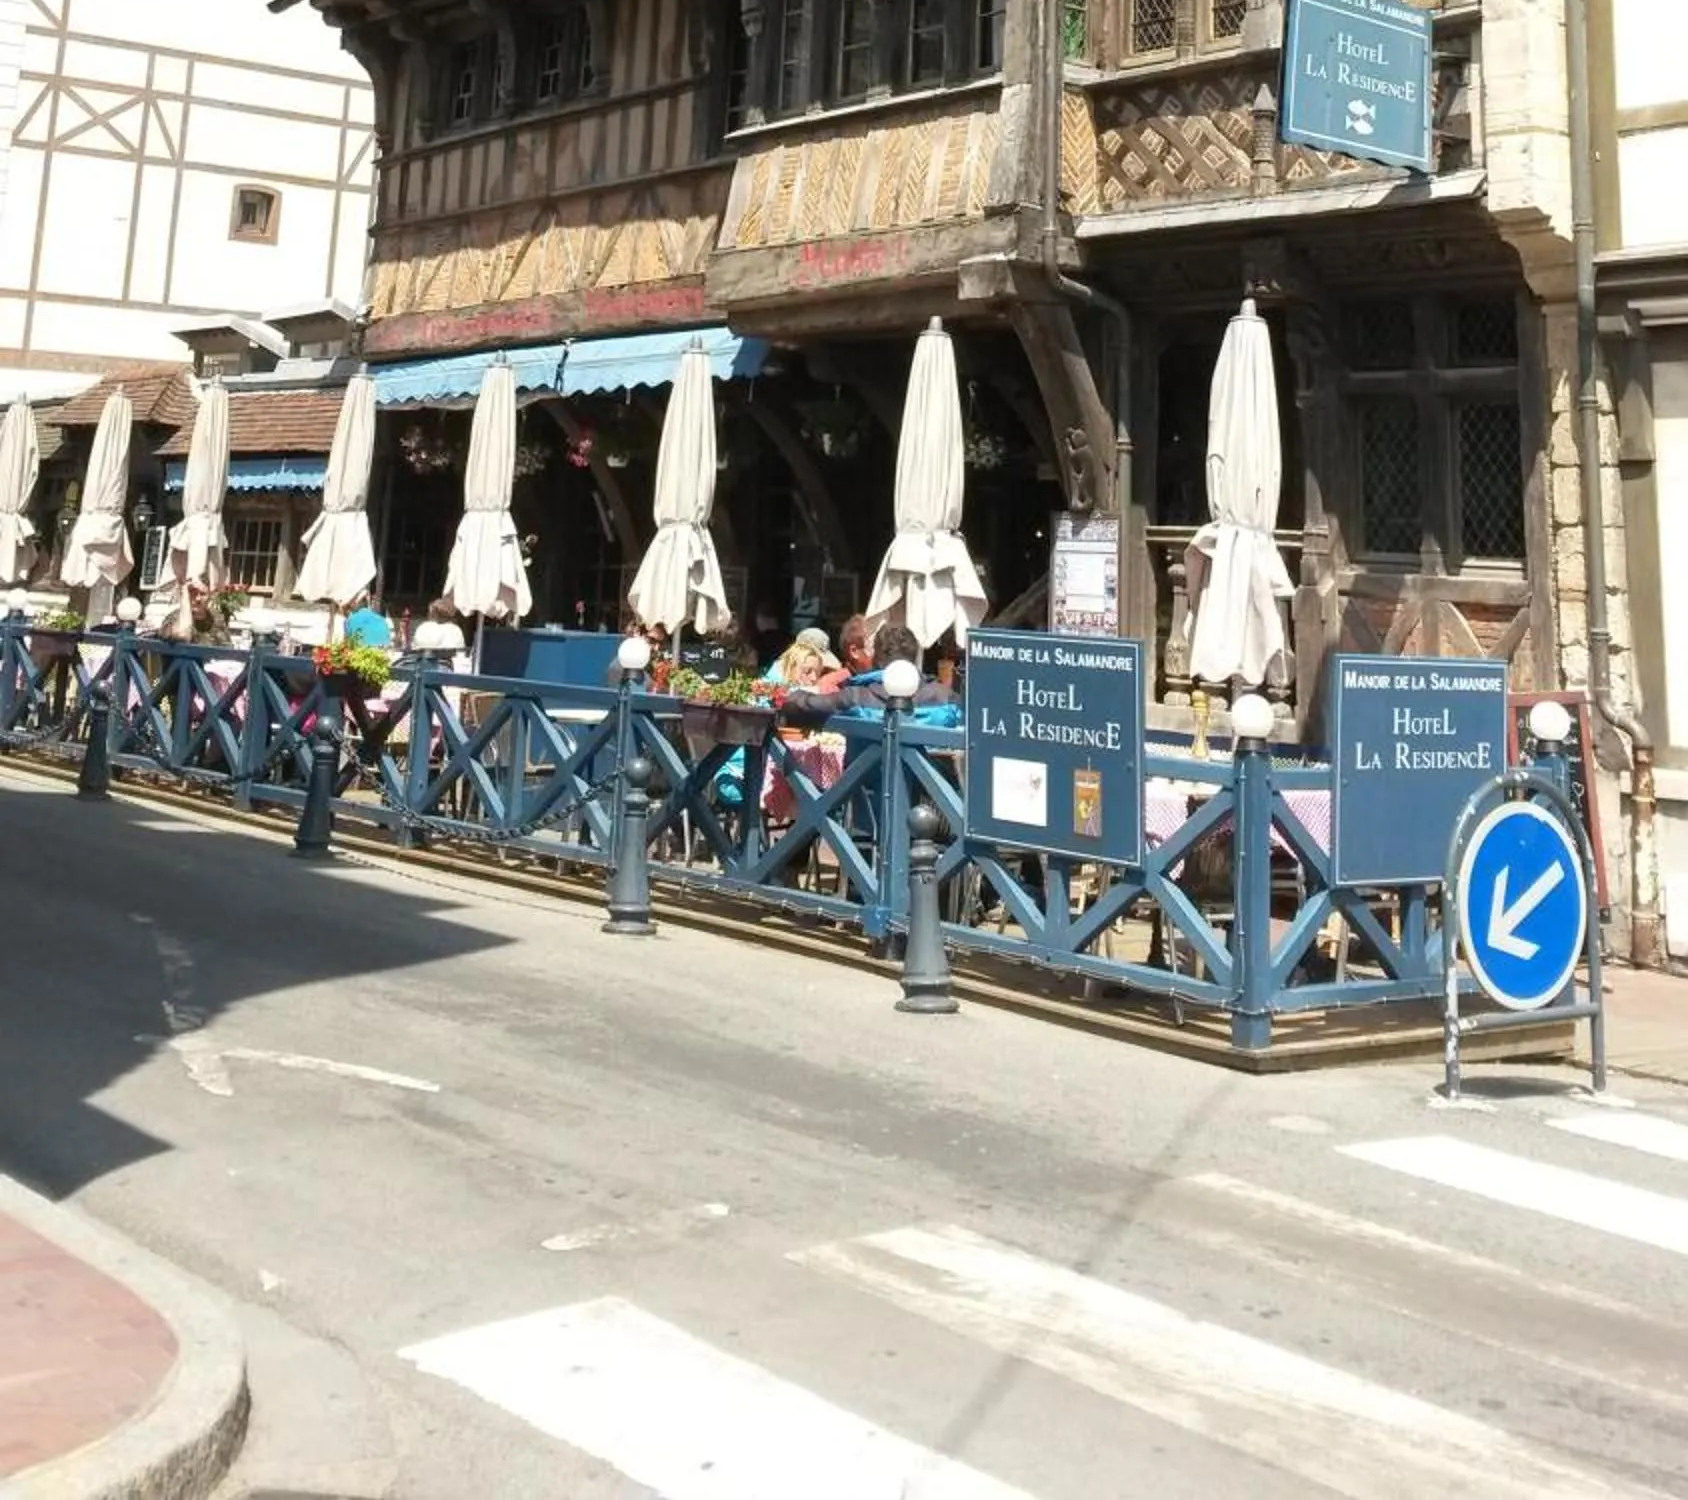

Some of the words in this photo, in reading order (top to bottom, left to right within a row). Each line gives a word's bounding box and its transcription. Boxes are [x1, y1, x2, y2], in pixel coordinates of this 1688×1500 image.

[971, 641, 1015, 661] MANOIR
[1018, 648, 1033, 663] DE
[1036, 650, 1050, 665] LA
[1055, 647, 1134, 671] SALAMANDRE
[1345, 670, 1390, 689] MANOIR
[1395, 675, 1409, 690] DE
[1412, 676, 1425, 691] LA
[1430, 673, 1504, 691] SALAMANDRE
